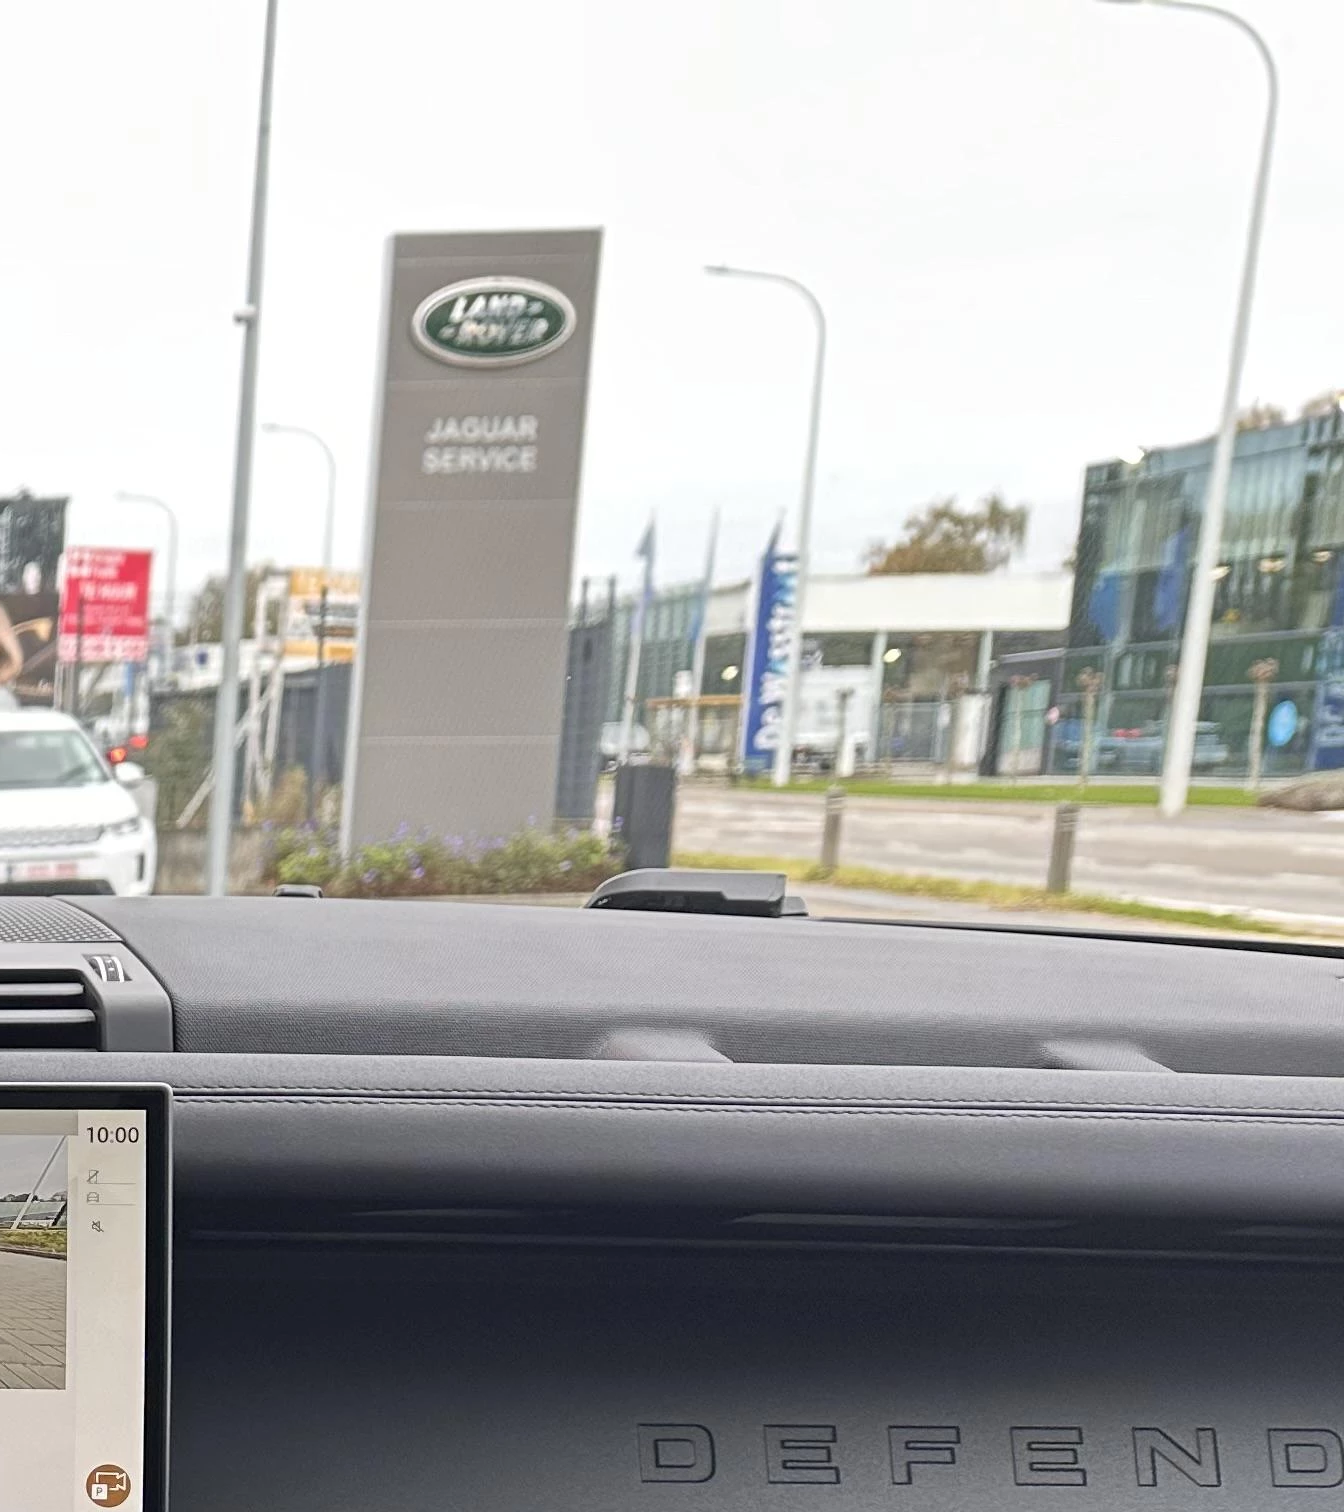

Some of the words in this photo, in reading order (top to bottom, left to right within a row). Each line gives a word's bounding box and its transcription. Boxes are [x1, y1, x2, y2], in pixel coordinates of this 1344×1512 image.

[425, 415, 538, 443] JAGUAR
[422, 446, 538, 475] SERVICE
[86, 1126, 140, 1144] 10:00
[637, 1423, 1344, 1488] DEFEND
